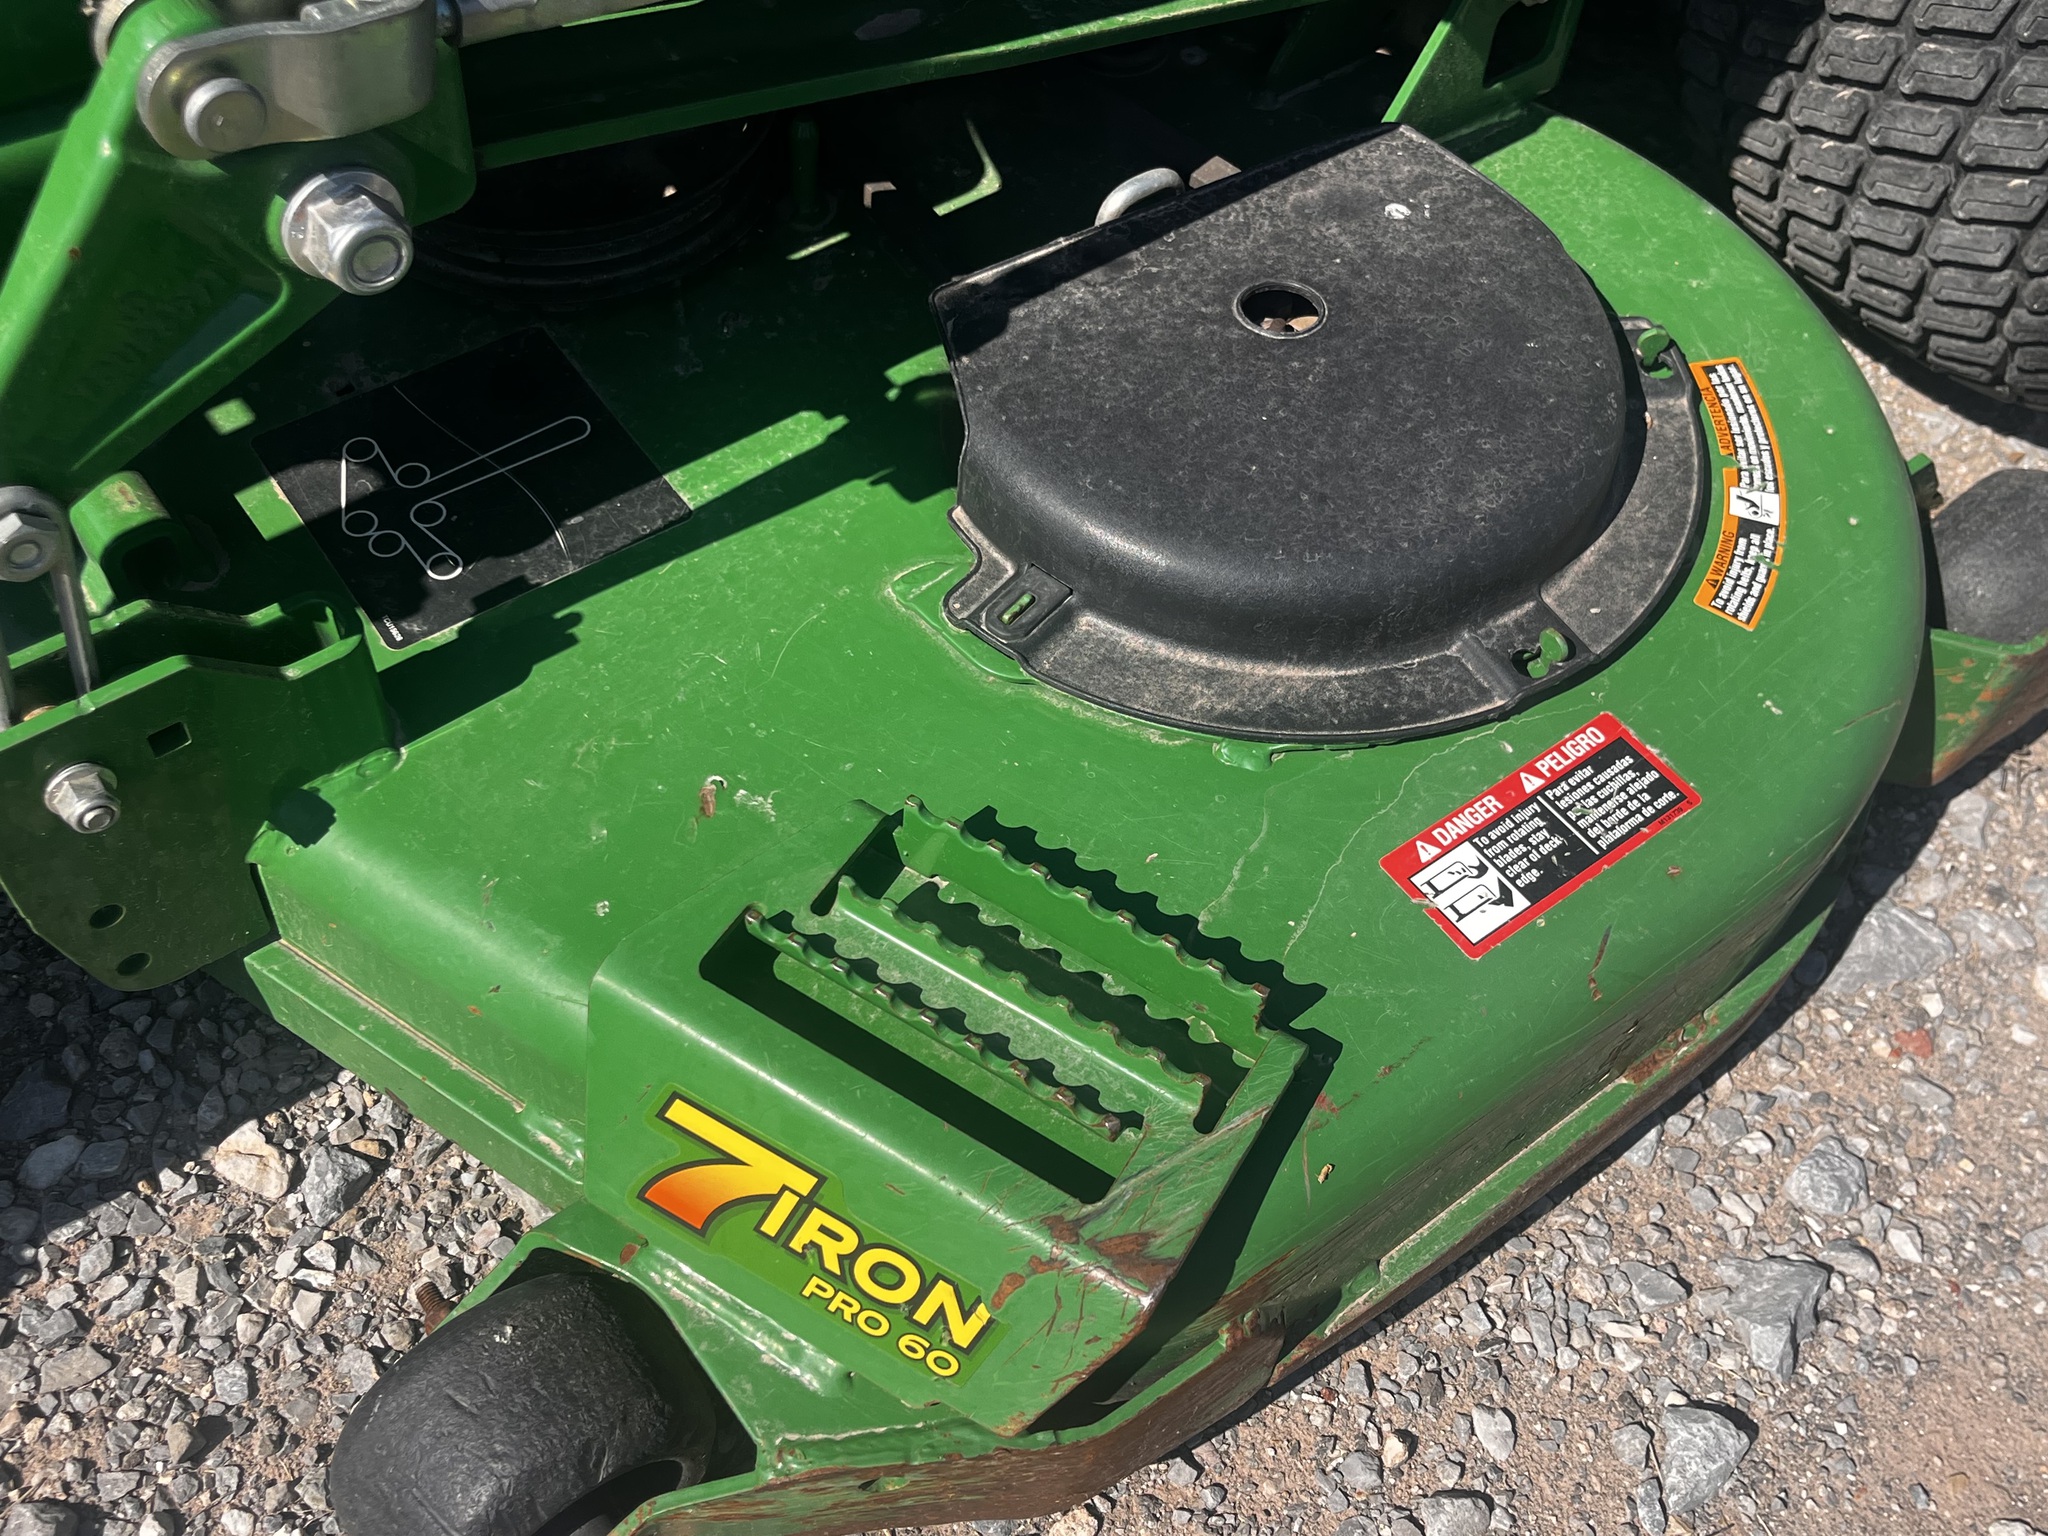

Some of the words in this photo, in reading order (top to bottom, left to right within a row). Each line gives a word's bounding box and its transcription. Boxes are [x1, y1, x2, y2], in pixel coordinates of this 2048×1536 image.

[1701, 387, 1732, 451] ADVERTENCIA
[1710, 530, 1735, 577] WARNING
[1725, 555, 1746, 578] injury
[1733, 536, 1747, 556] from
[1718, 576, 1735, 599] avoid
[1724, 585, 1747, 615] rotating
[1749, 532, 1761, 546] all
[1710, 597, 1724, 608] To
[1737, 595, 1756, 622] shields
[1749, 580, 1762, 597] and
[1432, 794, 1504, 847] DANGER
[1535, 726, 1606, 778] PELIGRO
[1544, 780, 1570, 800] Para
[1567, 765, 1594, 786] evitar
[1554, 781, 1595, 809] lesiones
[1592, 755, 1634, 785] causadas
[1580, 794, 1598, 810] las
[1596, 769, 1640, 799] cuchillas,
[1625, 769, 1659, 795] alejado
[1472, 835, 1489, 847] To
[1487, 817, 1515, 840] avoid
[1510, 801, 1541, 823] injury
[1586, 822, 1604, 838] del
[1599, 807, 1629, 828] borde
[1626, 798, 1641, 811] de
[1636, 788, 1651, 803] la
[1596, 813, 1644, 850] plataforma
[1641, 805, 1655, 817] de
[1652, 790, 1679, 809] corte.
[1482, 839, 1509, 858] from
[1505, 816, 1545, 843] rotating
[1492, 843, 1531, 868] blades,
[1527, 827, 1552, 849] stay
[1504, 857, 1530, 877] clear
[1528, 848, 1541, 861] of
[1538, 833, 1562, 855] deck
[1515, 868, 1543, 887] edge.
[753, 1184, 995, 1355] IRON
[801, 1274, 891, 1337] PRO
[897, 1333, 960, 1377] 60
